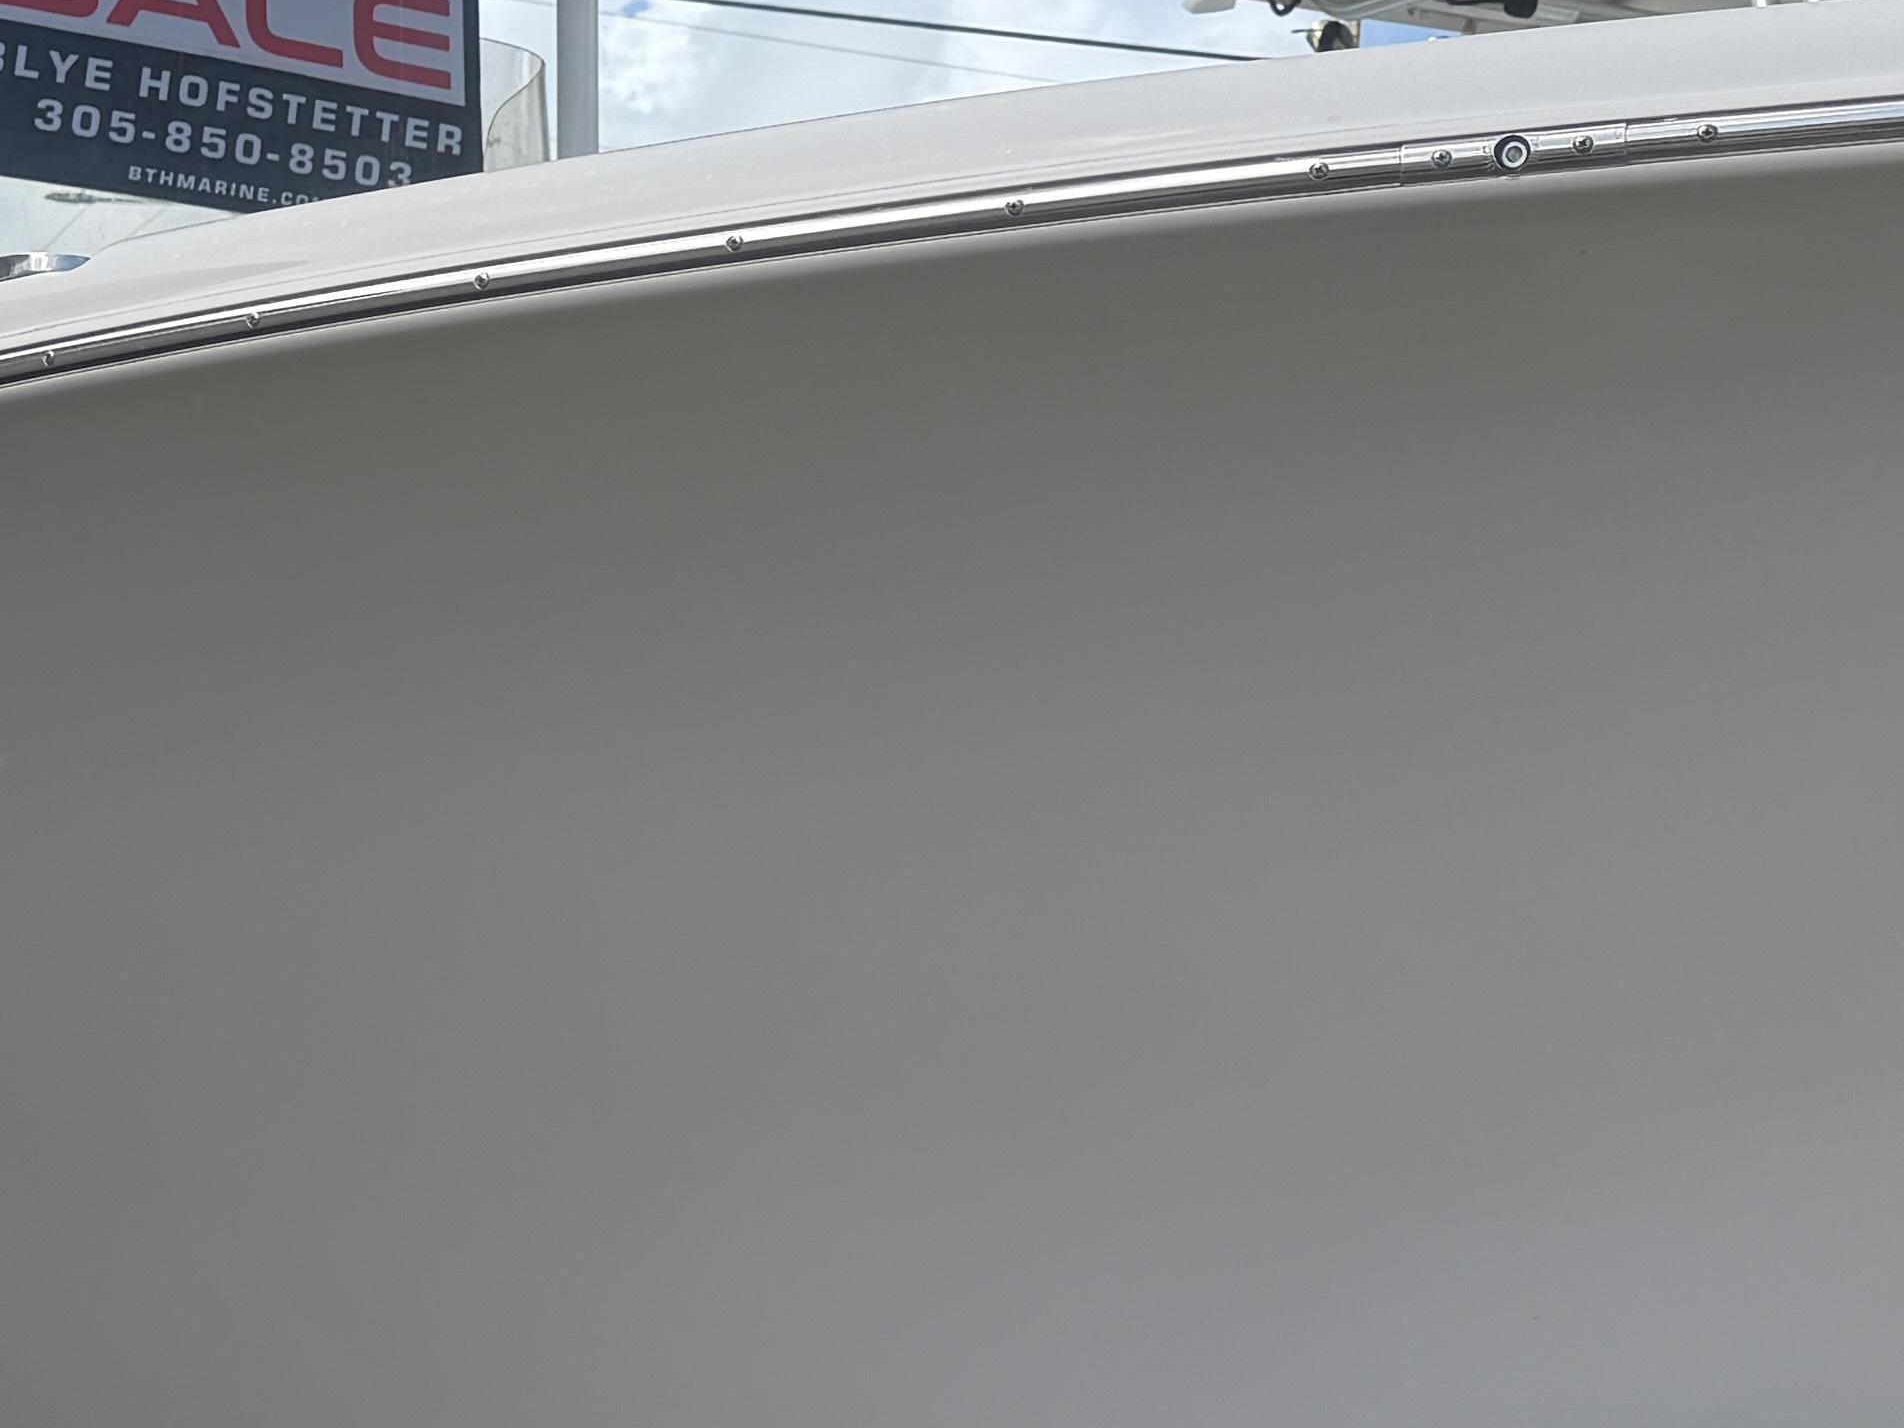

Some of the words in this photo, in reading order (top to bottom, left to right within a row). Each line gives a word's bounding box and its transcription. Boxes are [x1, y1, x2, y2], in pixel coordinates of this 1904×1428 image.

[34, 99, 414, 188] 305-850-8503
[139, 67, 463, 155] HOFSTETTER
[127, 165, 319, 206] BTHMARINE.CO
